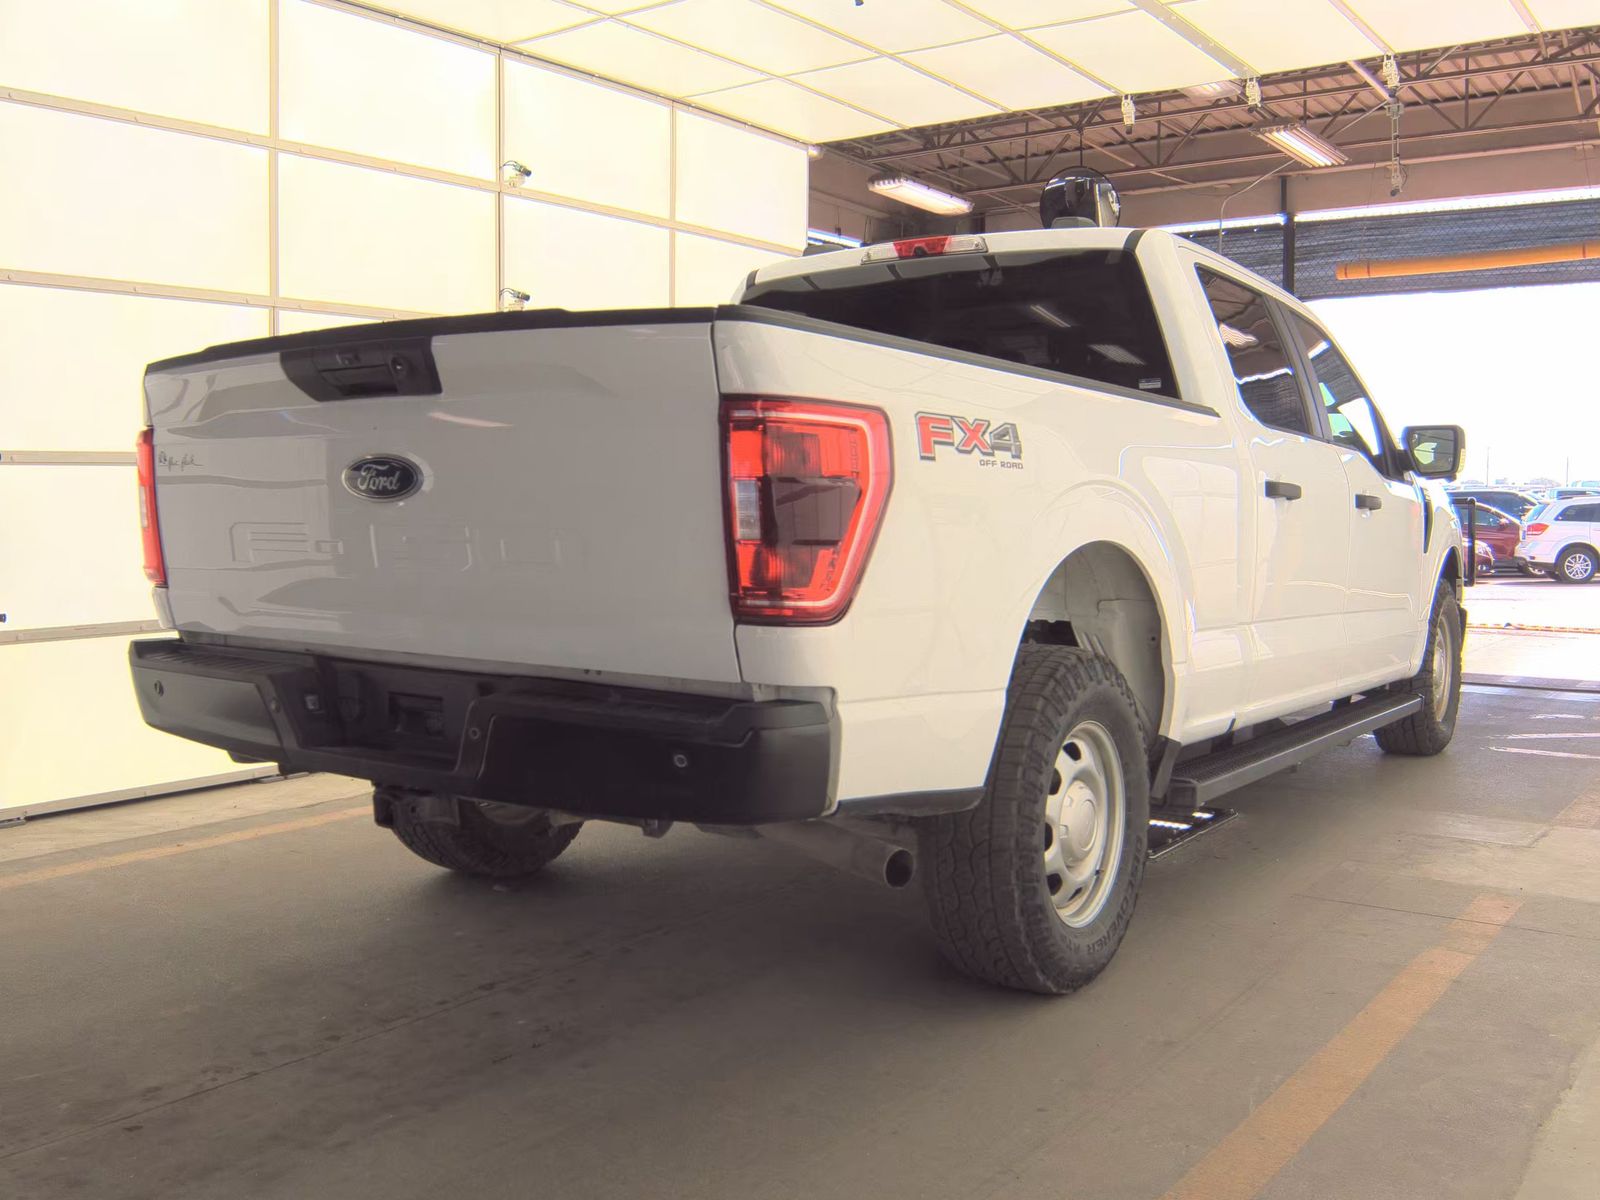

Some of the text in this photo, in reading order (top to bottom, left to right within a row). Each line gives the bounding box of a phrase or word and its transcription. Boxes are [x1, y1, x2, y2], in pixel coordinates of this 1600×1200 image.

[914, 411, 1022, 461] FX4
[358, 463, 401, 491] Ford
[979, 459, 1024, 470] OFF ROAD
